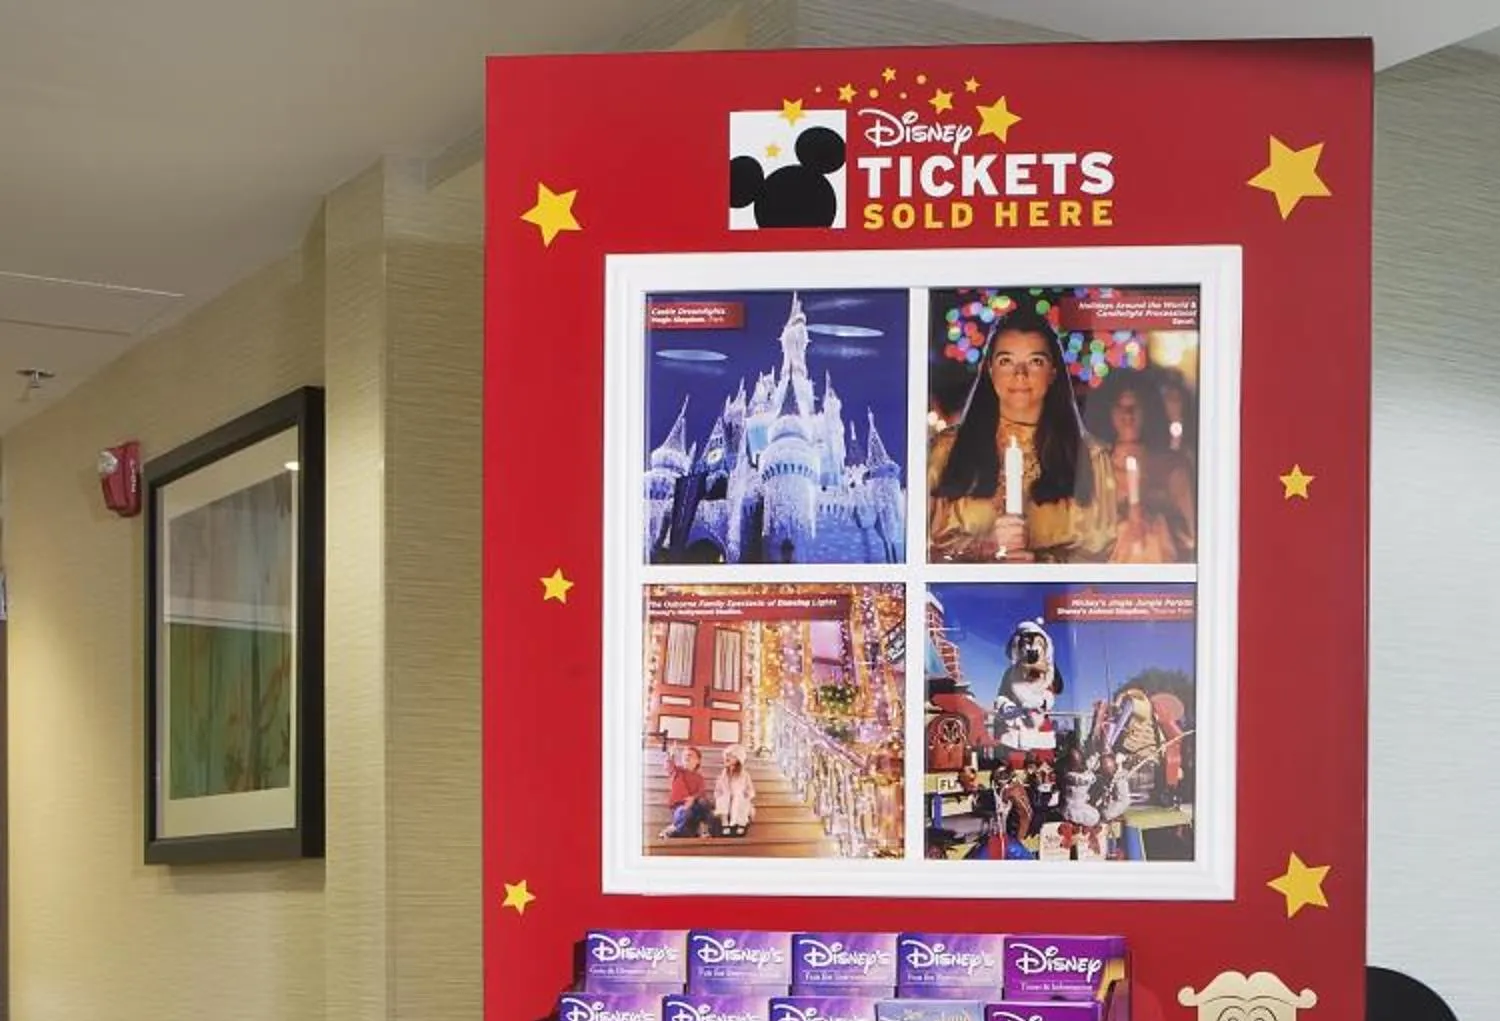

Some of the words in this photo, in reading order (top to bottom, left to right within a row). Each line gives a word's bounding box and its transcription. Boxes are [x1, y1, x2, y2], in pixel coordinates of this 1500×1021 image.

[858, 109, 972, 155] Disney
[857, 152, 1115, 198] TICKETS
[863, 203, 973, 229] SOLD
[995, 200, 1113, 227] HERE
[588, 933, 678, 964] Disney's
[693, 935, 784, 965] Disney's
[799, 939, 892, 975] Disney's
[902, 939, 995, 975] Disney's
[1010, 943, 1101, 982] Disney
